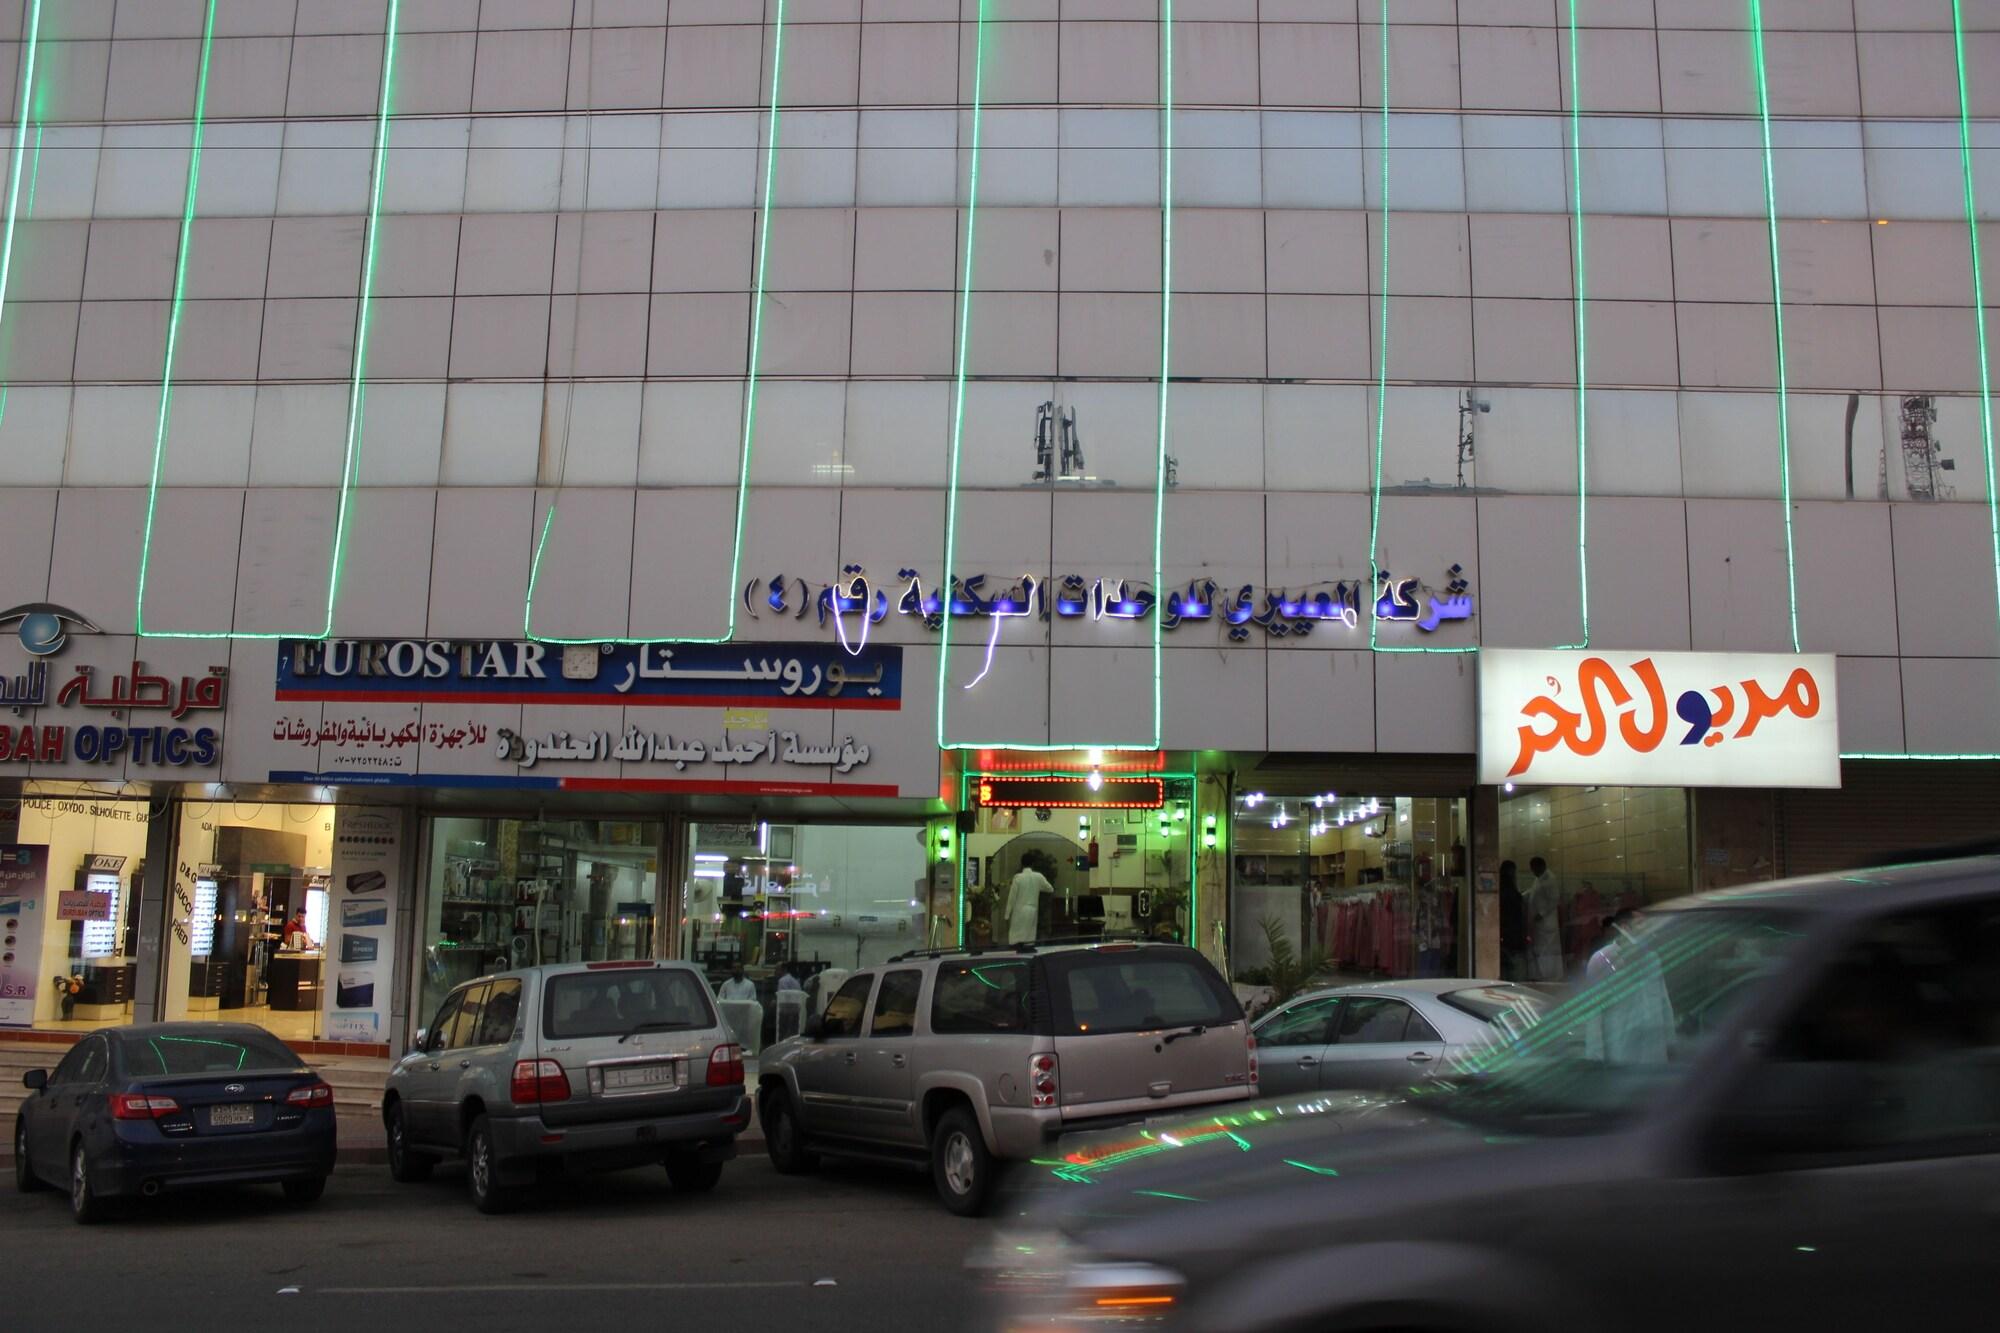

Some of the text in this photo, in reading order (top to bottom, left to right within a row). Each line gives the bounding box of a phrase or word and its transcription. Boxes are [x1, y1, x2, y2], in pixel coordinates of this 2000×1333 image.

[898, 568, 1049, 629] السكنية
[1369, 563, 1473, 632] شركة
[292, 639, 547, 679] EUROSTAR
[614, 643, 884, 697] يوروستار
[57, 661, 223, 719] قرطبة
[74, 725, 217, 765] OPTICS
[430, 720, 488, 750] للأجهزة
[712, 729, 777, 764] أحمد
[782, 730, 871, 773] مؤسسة
[23, 799, 52, 810] POLICE
[58, 801, 84, 814] OXYDO
[90, 805, 131, 821] SILHOUETTE
[175, 882, 194, 916] GUCCI
[172, 918, 189, 946] FRED
